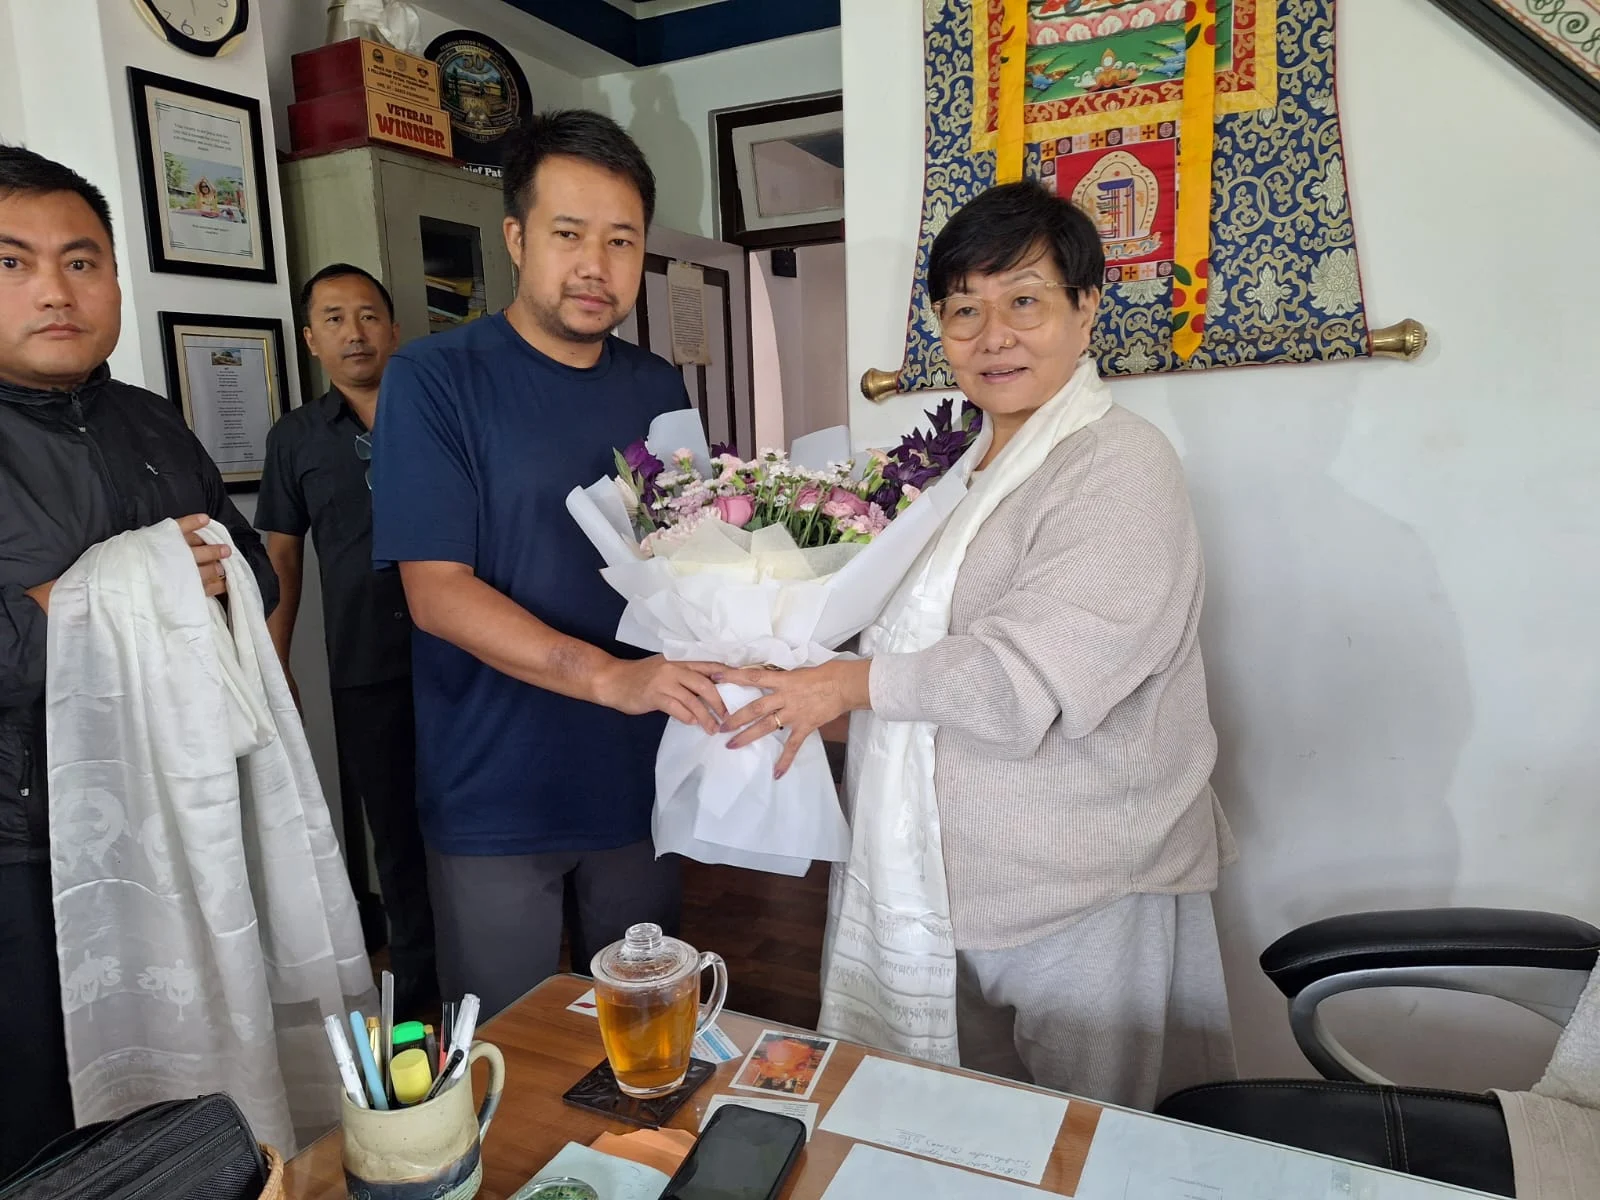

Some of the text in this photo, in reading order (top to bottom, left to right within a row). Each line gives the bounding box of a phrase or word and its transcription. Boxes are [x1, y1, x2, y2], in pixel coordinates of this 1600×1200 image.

[164, 10, 171, 20] 7
[216, 16, 224, 25] 4
[182, 20, 194, 36] 6
[203, 25, 211, 37] 5
[386, 102, 433, 126] VETERAN
[375, 113, 446, 150] WINNER
